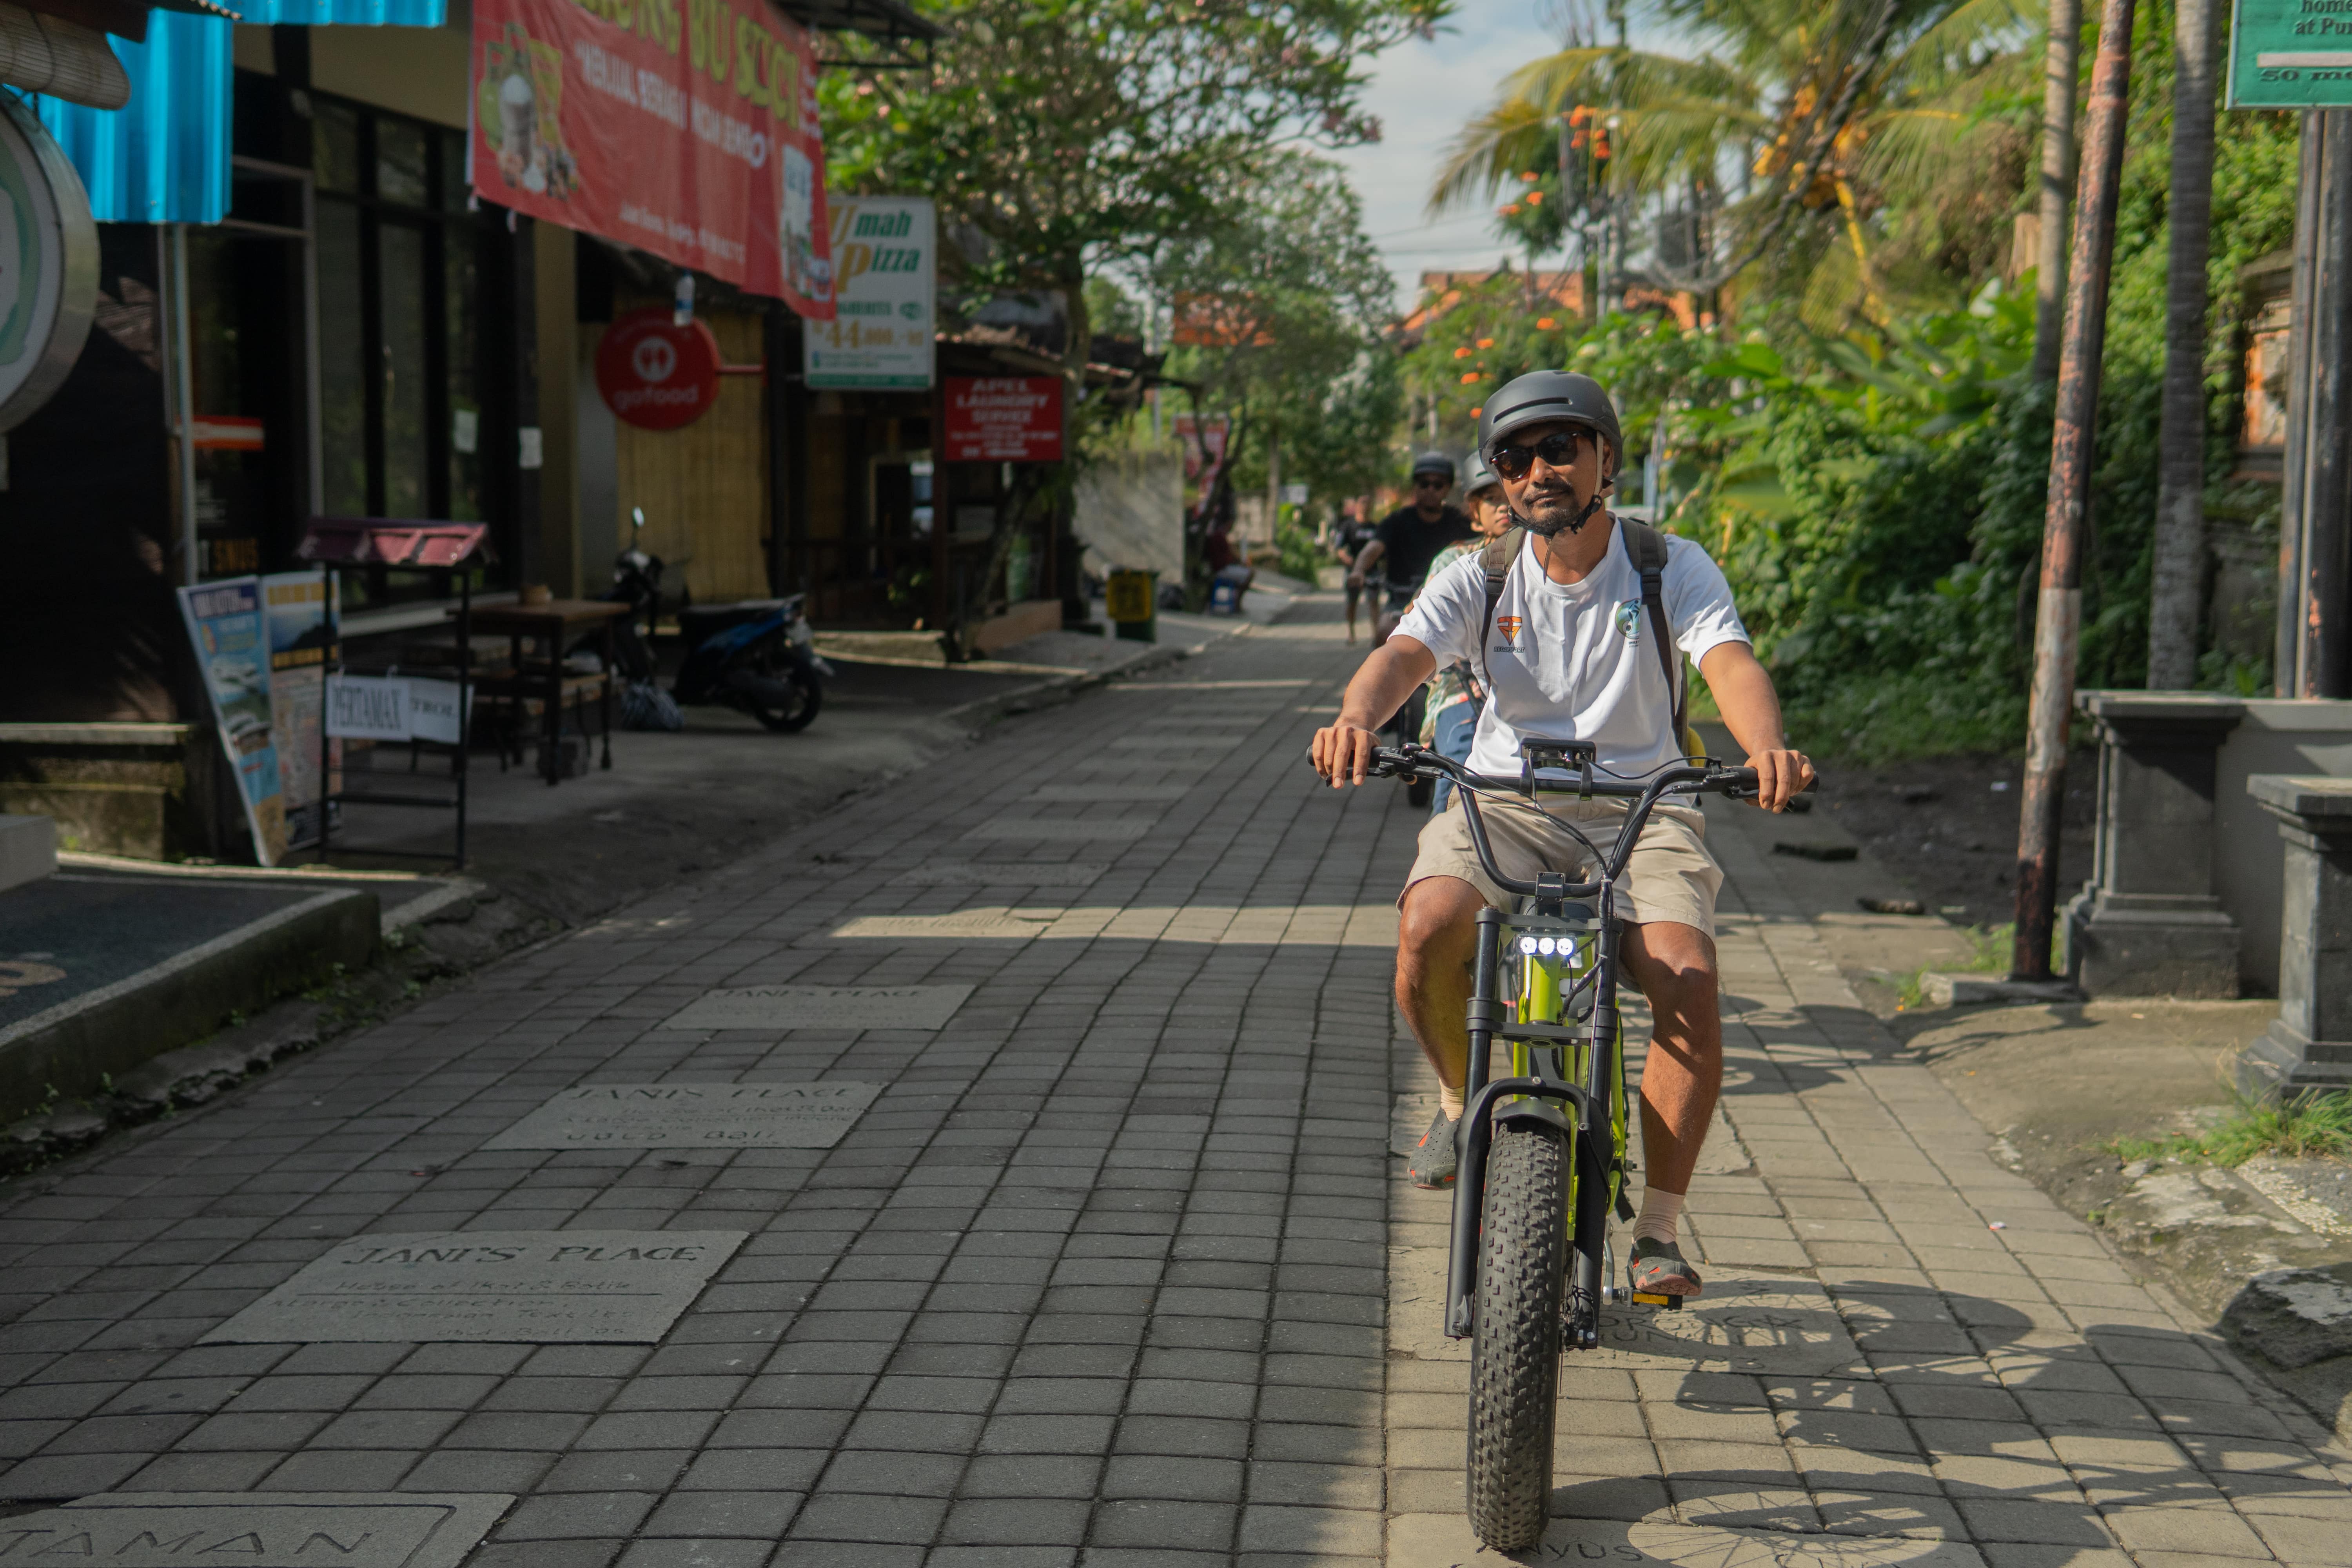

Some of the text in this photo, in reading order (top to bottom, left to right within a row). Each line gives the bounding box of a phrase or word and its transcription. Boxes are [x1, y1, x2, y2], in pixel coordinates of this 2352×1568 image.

[2295, 18, 2314, 34] at
[2259, 69, 2299, 82] 50
[546, 1246, 706, 1262] PLACE
[0, 1529, 378, 1558] TAMAN
